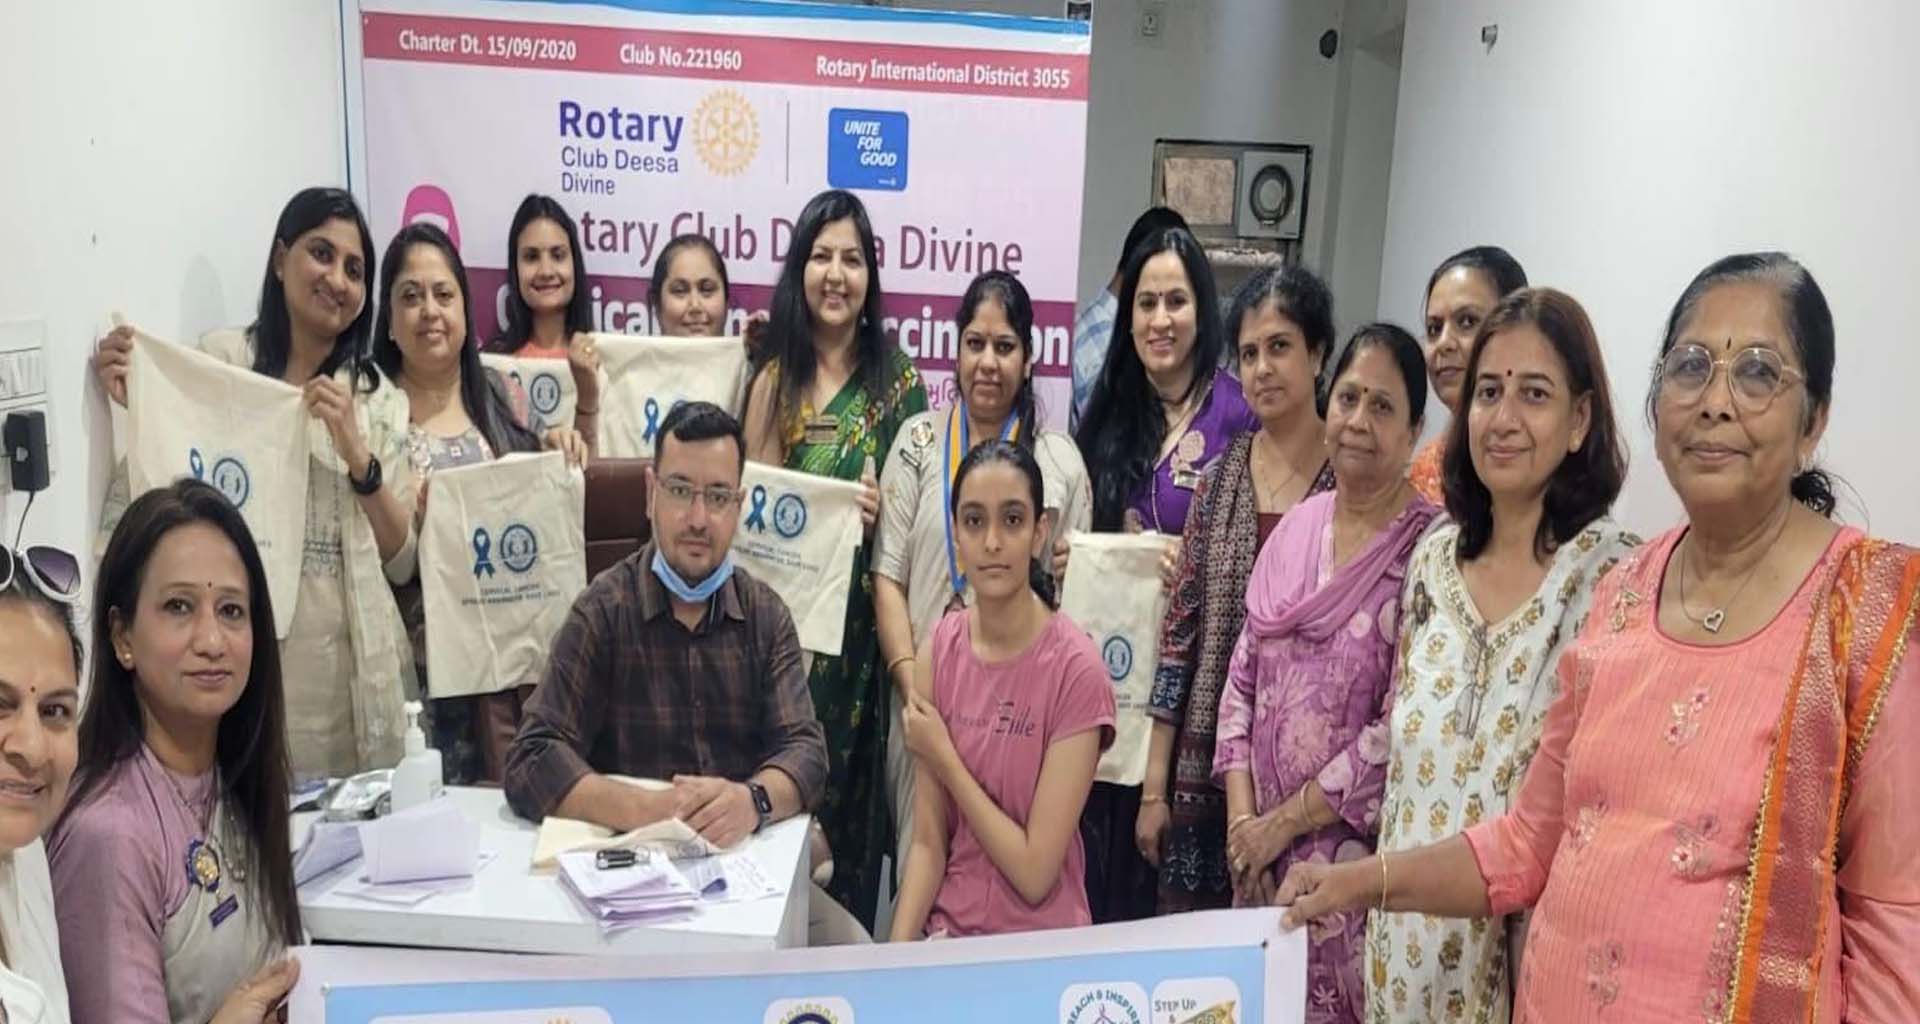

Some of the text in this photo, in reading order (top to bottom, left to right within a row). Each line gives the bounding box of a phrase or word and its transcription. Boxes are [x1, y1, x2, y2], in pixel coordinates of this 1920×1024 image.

[399, 30, 577, 61] Charter Dt. 15/09/2020
[619, 43, 742, 71] Club No.221960
[816, 55, 1070, 89] Rotary International District 3055
[559, 100, 685, 152] Rotary
[844, 120, 881, 136] UNITE
[857, 136, 882, 150] FOR
[561, 145, 679, 173] Club Deesa
[860, 152, 897, 168] GOOD
[561, 172, 616, 195] Divine
[581, 210, 659, 267] tary
[900, 225, 1023, 276] Divine
